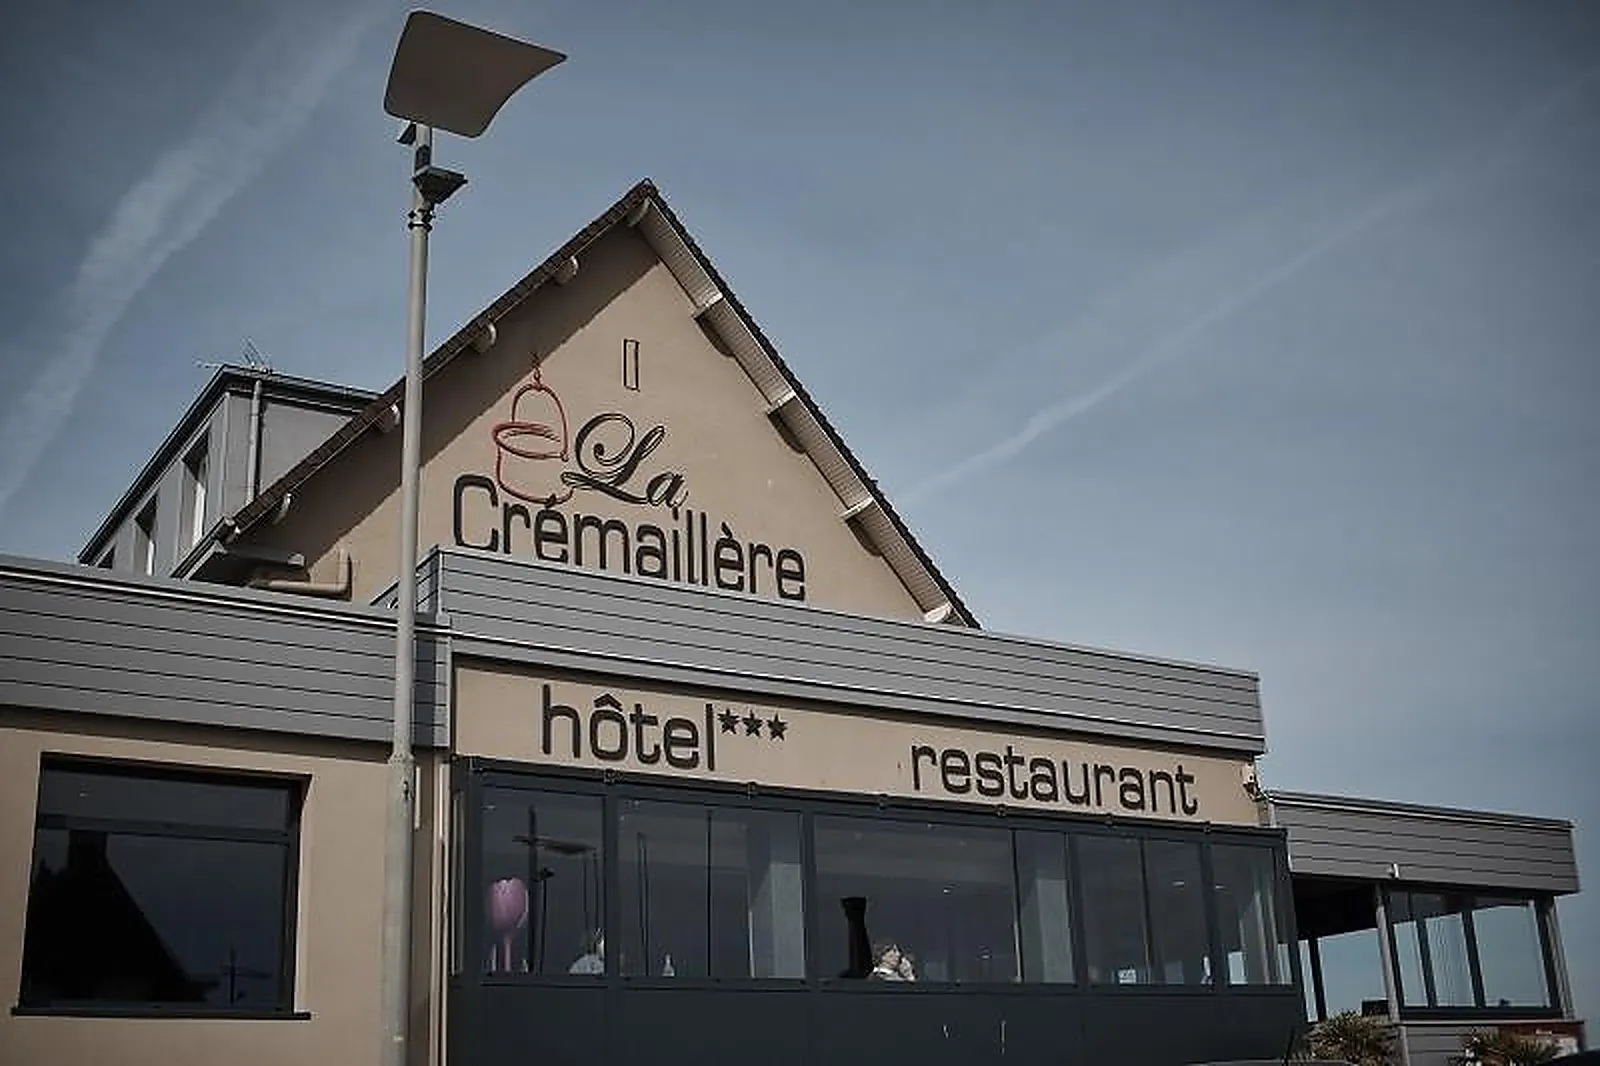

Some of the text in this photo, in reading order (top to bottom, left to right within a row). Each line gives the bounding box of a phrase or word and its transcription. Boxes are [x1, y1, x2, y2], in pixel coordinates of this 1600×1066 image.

[561, 413, 688, 508] La
[453, 474, 806, 601] Crémaillère
[542, 684, 1199, 815] hôtel restaurant
